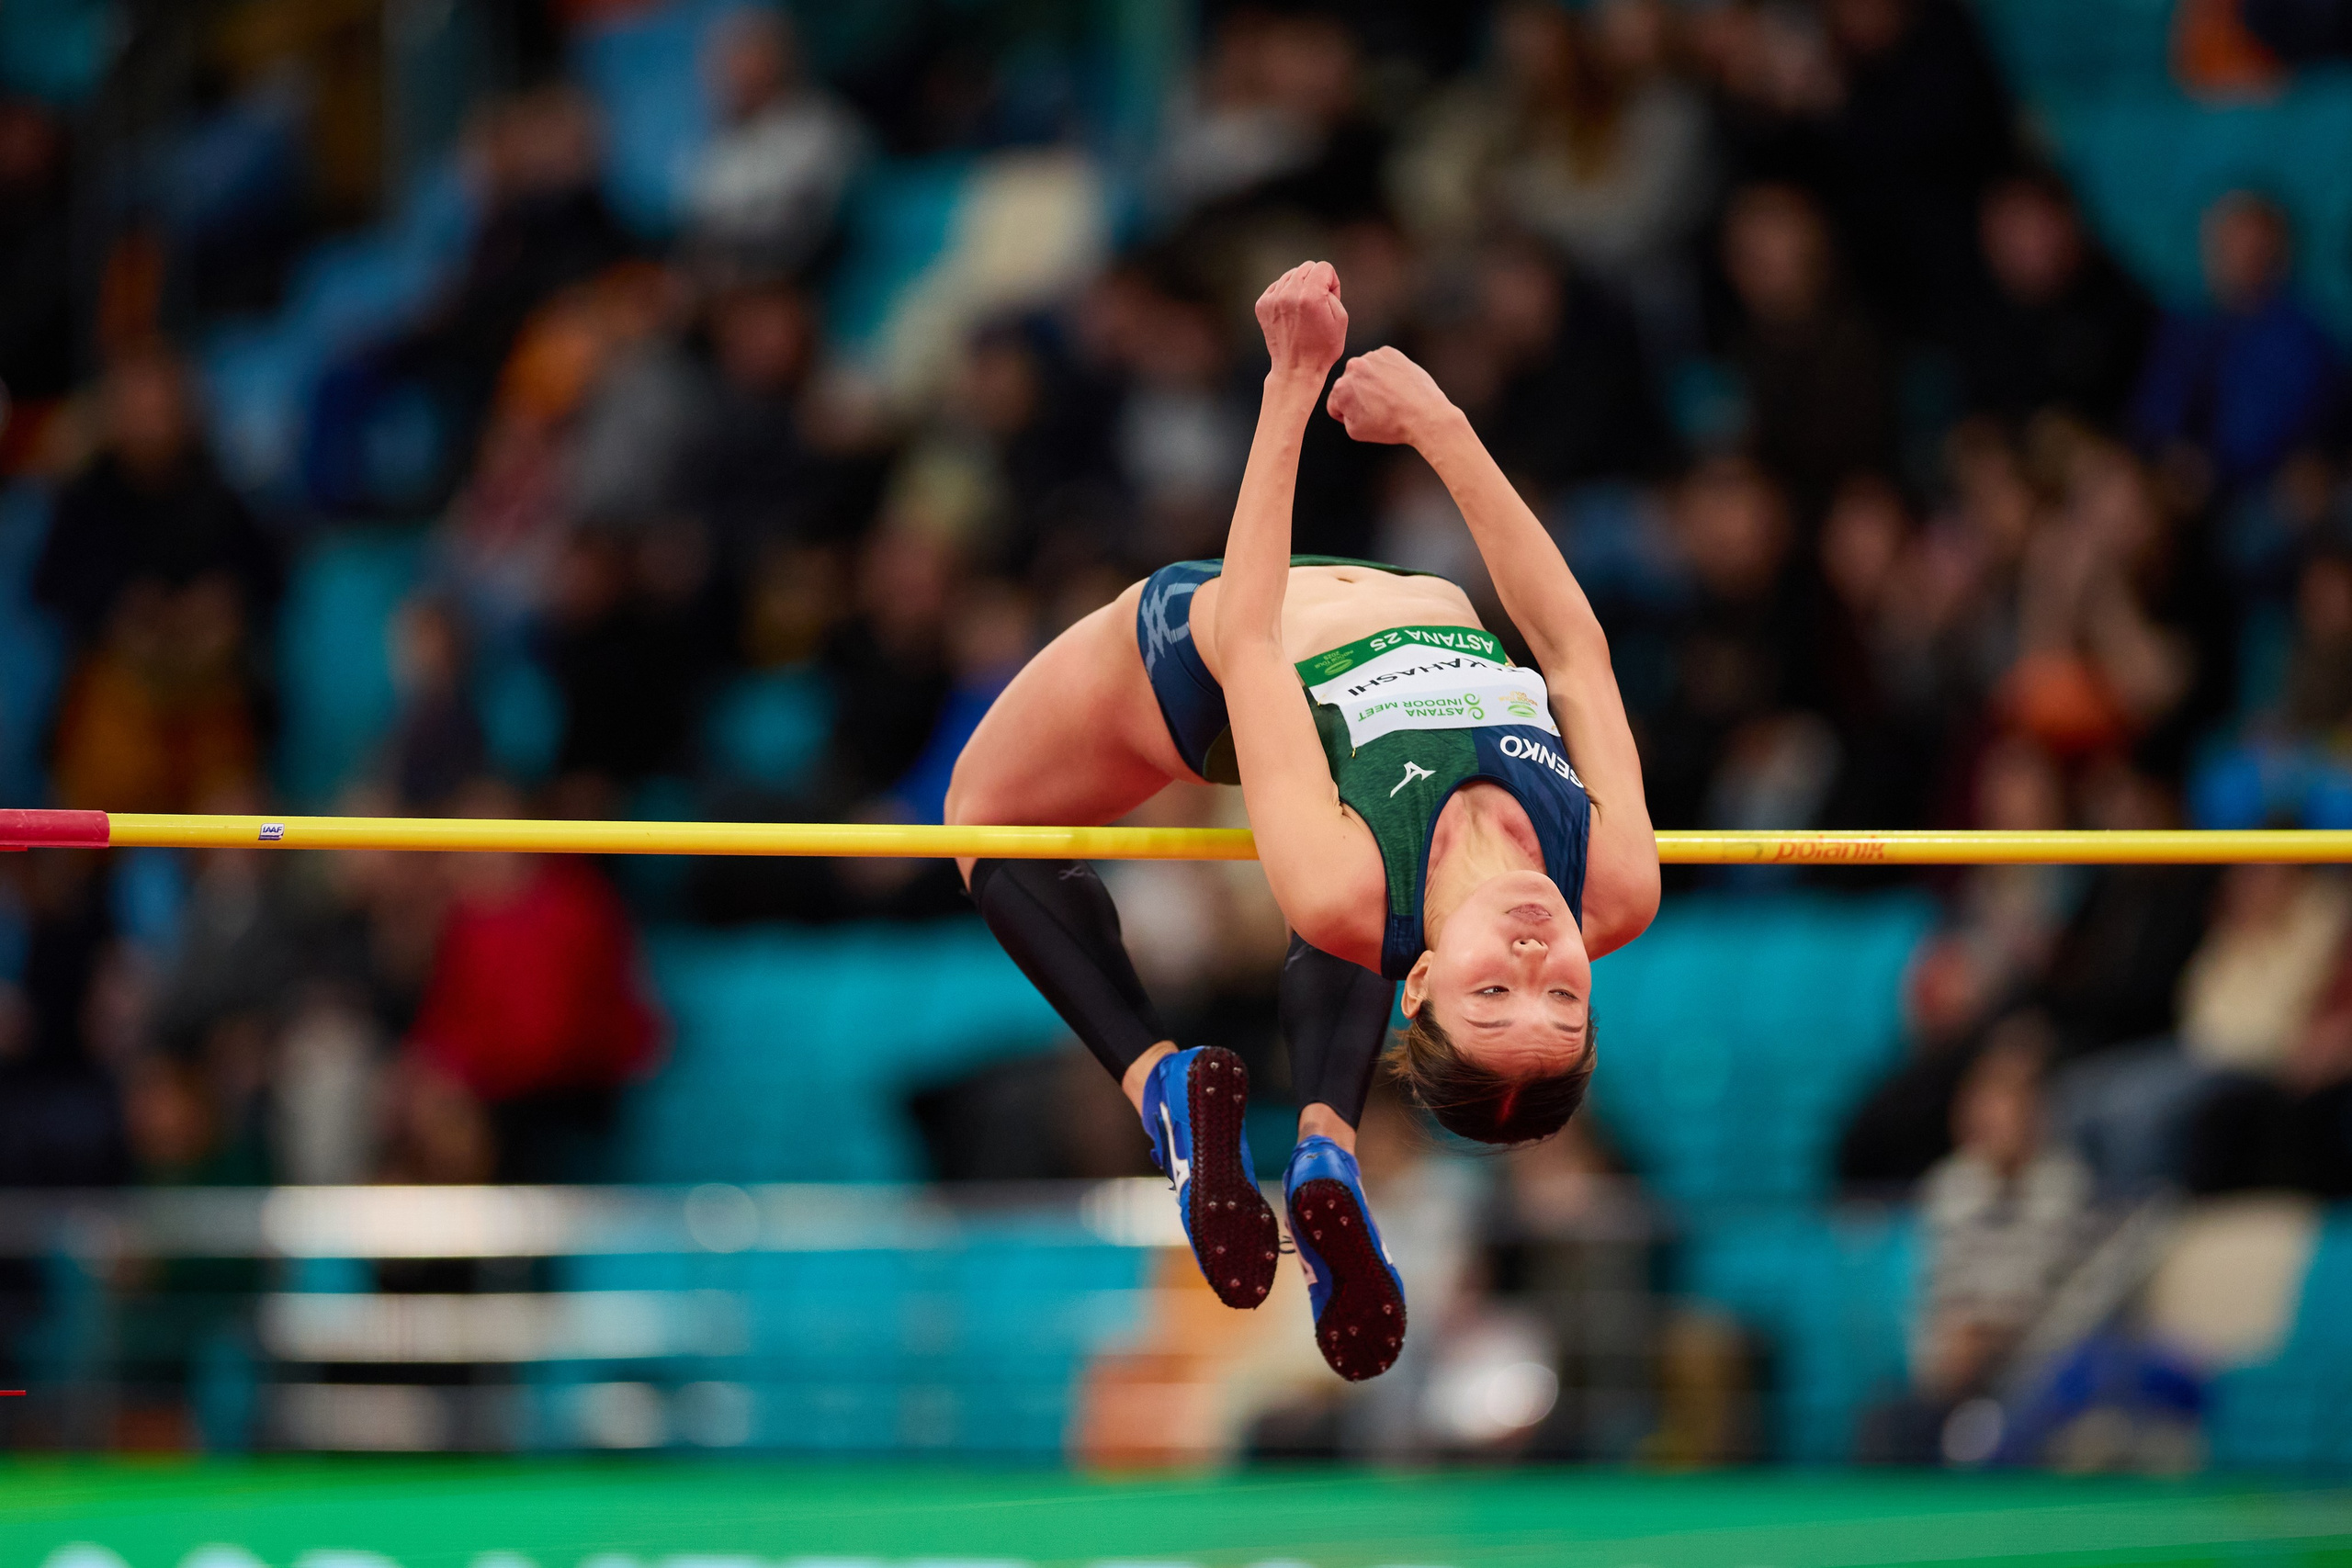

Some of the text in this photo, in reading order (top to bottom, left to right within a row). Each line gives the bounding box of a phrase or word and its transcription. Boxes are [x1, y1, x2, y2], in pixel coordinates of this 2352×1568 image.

[1369, 629, 1494, 655] ASTANA 25
[1348, 658, 1525, 696] KAHASHI
[1357, 698, 1463, 722] INDOOR MEET
[1405, 706, 1464, 717] ASTANA
[1499, 735, 1585, 789] SENKO
[1772, 834, 1885, 863] polanik
